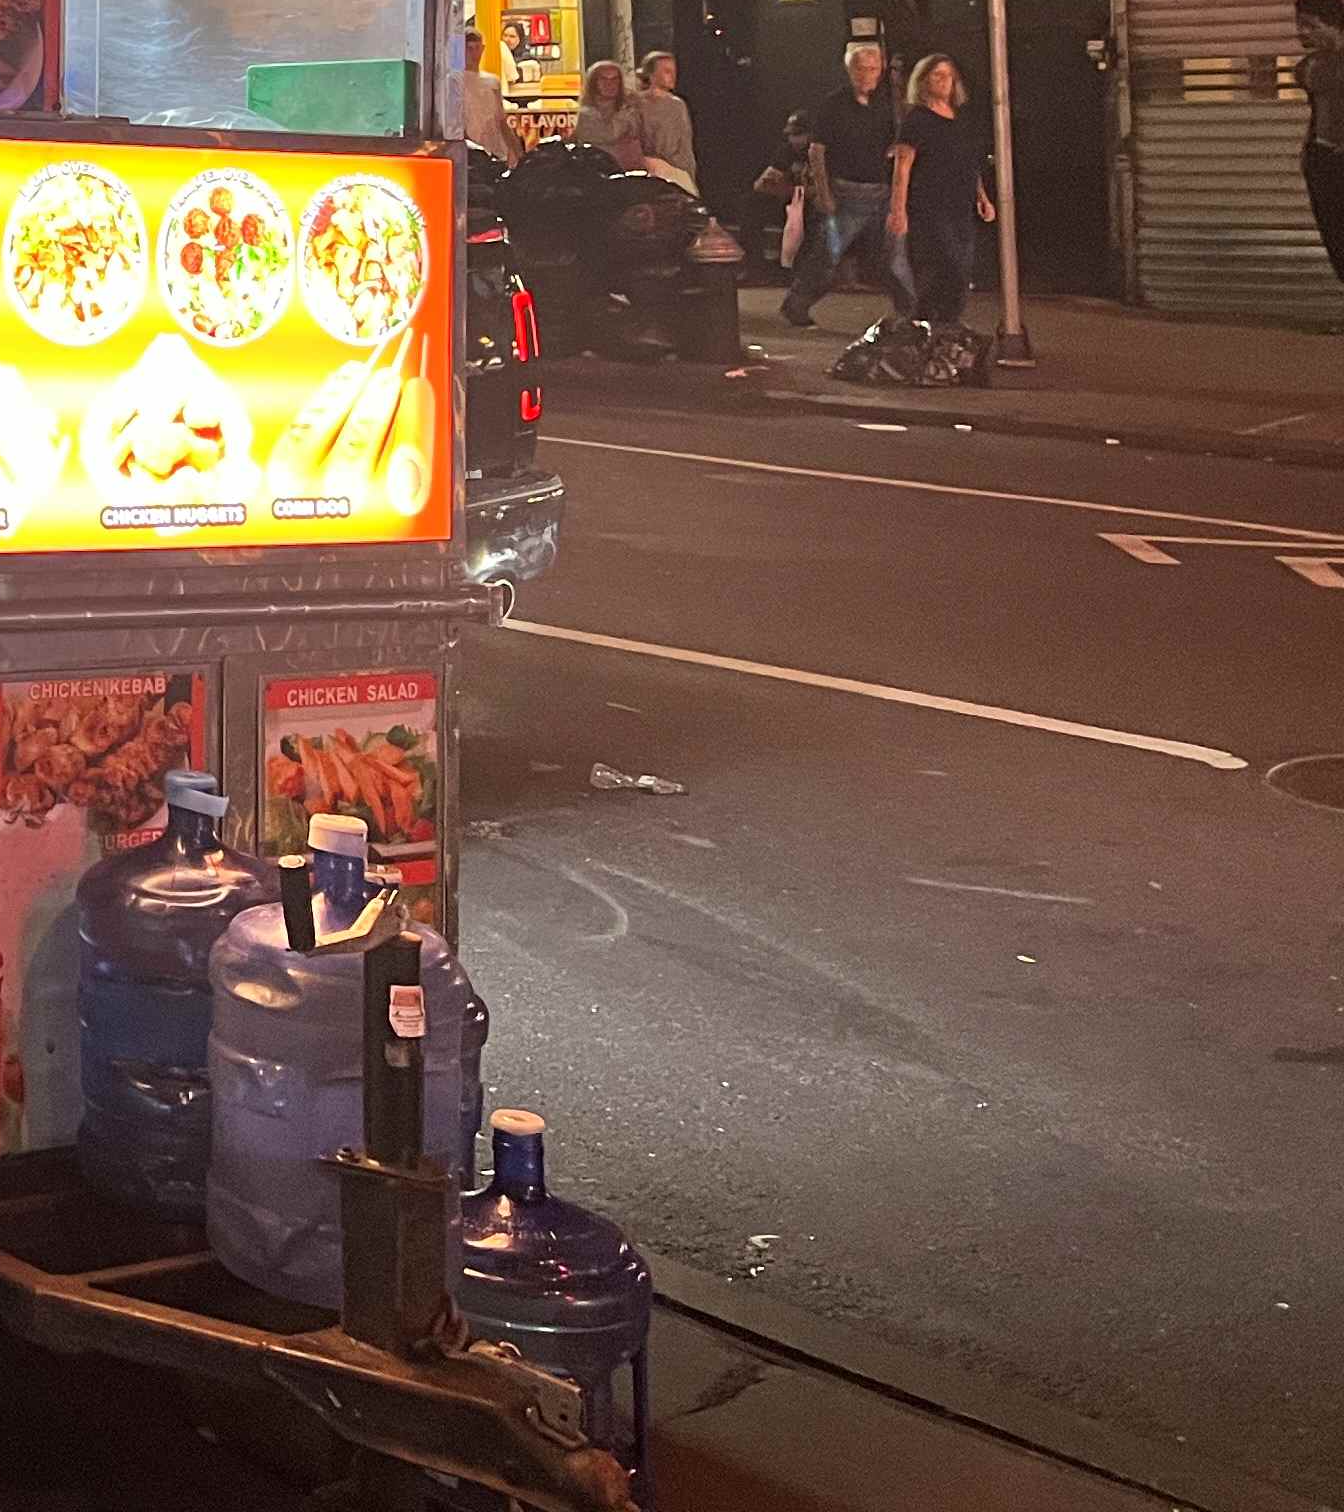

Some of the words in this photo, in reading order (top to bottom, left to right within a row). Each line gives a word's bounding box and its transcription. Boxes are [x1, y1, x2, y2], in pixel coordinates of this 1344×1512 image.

[30, 681, 103, 701] CHICKEN
[110, 676, 167, 696] KEBAB
[286, 687, 359, 707] CHICKEN
[365, 681, 419, 702] SALAD
